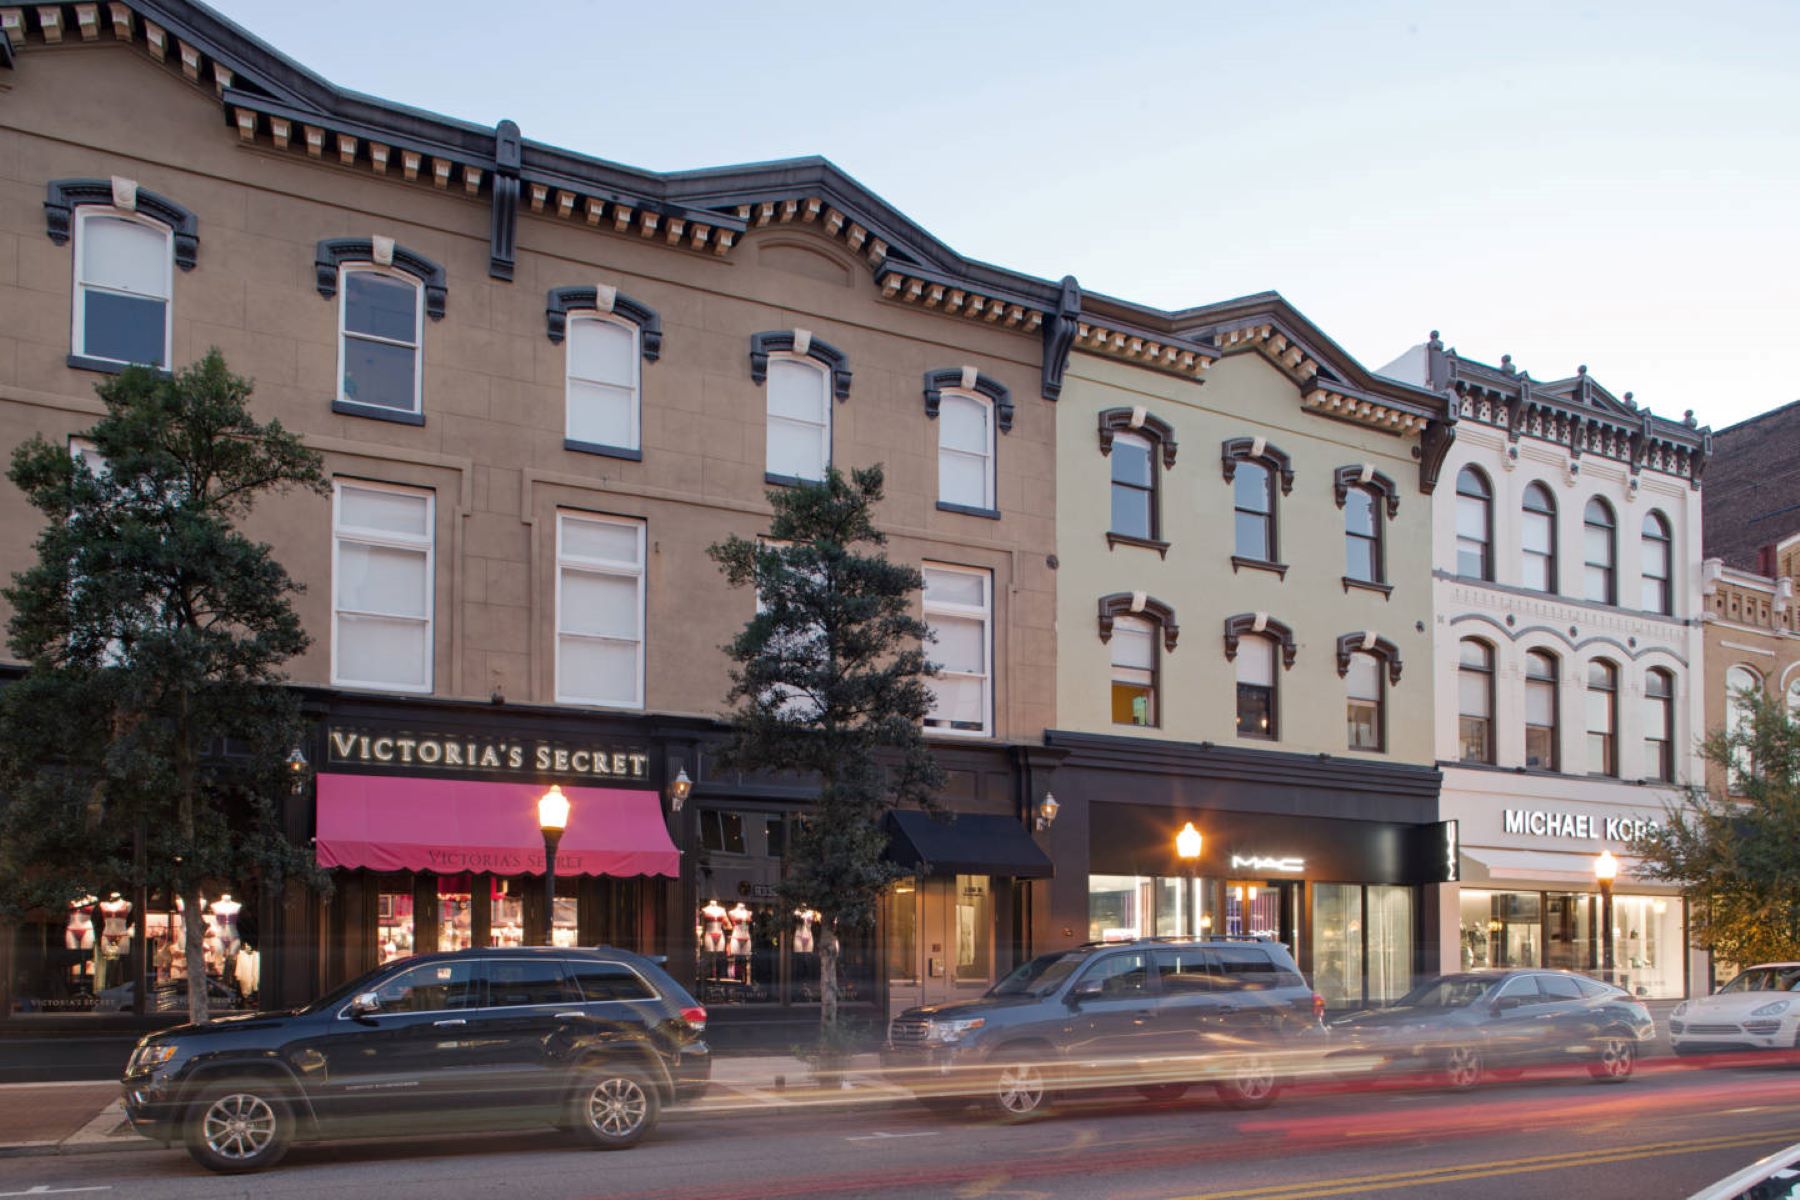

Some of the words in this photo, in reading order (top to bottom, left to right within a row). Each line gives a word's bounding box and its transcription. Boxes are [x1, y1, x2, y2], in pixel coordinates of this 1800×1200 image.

[332, 731, 523, 767] VICTORIA'S
[536, 746, 646, 775] SECRET
[1504, 809, 1599, 838] MICHAEL
[428, 850, 521, 868] VICTORIA'S
[528, 854, 583, 868] SERET
[1232, 855, 1304, 872] MAC
